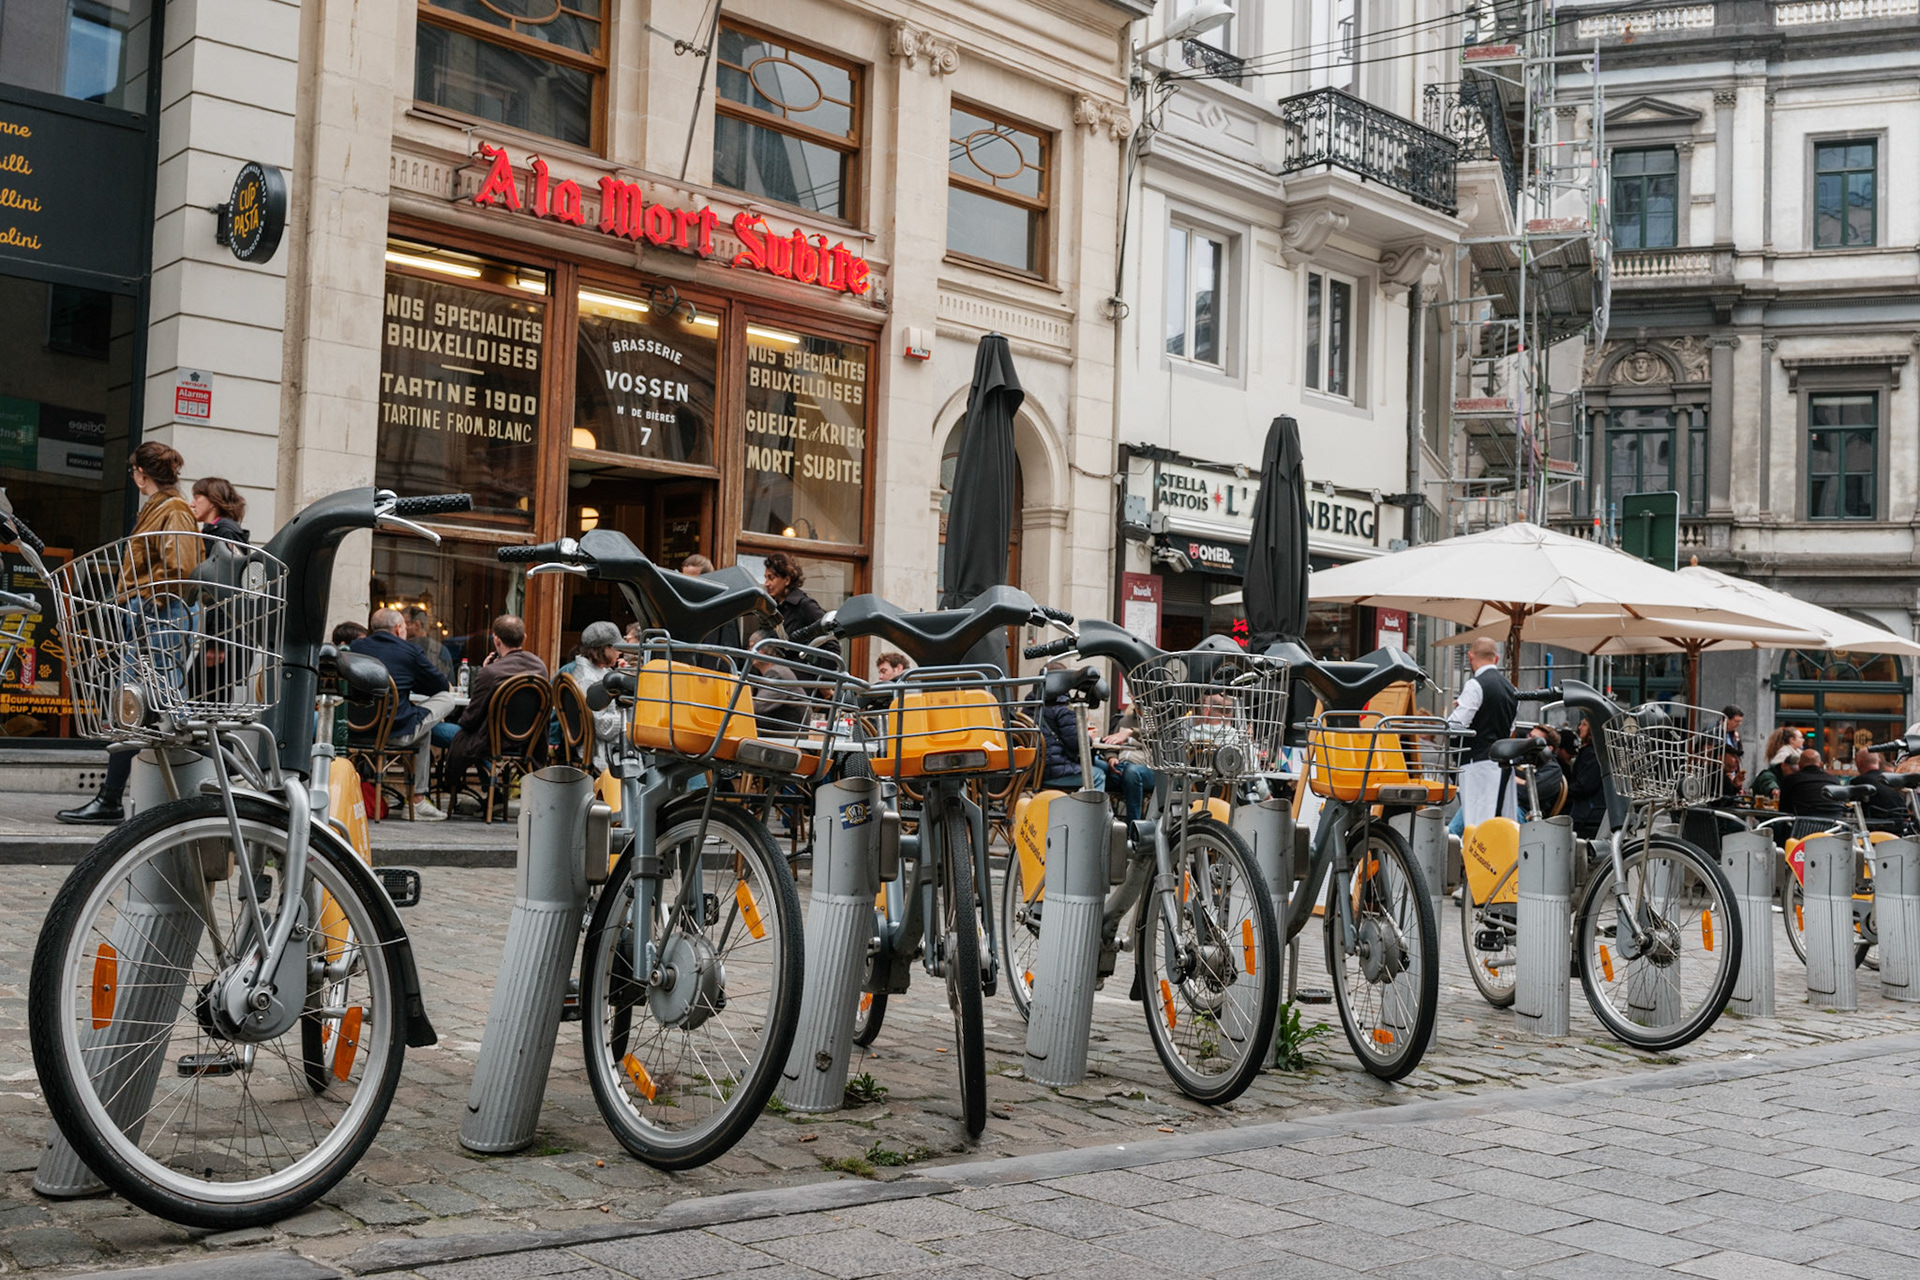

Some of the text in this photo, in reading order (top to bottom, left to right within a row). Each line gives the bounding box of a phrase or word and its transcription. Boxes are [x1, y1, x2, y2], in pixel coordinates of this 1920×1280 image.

[0, 154, 33, 175] illi
[0, 188, 42, 212] llini
[240, 181, 257, 211] CUP
[233, 203, 259, 238] PASTA
[473, 141, 871, 294] A la Mort Subite
[386, 293, 424, 321] NOS
[387, 323, 537, 370] BRUXELLOISES
[612, 338, 683, 365] BRASSERIE
[748, 344, 777, 365] NOS
[179, 389, 209, 399] Alarme
[382, 372, 537, 416] TARTINE 1900
[605, 369, 689, 403] VOSSEN
[750, 366, 863, 405] BRUXELLOISES
[383, 402, 441, 430] TARTINE
[631, 408, 642, 418] DE
[645, 410, 676, 424] BIÈRES
[746, 409, 807, 440] GUEUZE
[819, 422, 866, 449] KRIEK
[640, 427, 652, 446] 7
[1160, 472, 1207, 494] STELLA
[1160, 490, 1208, 511] ARTOIS
